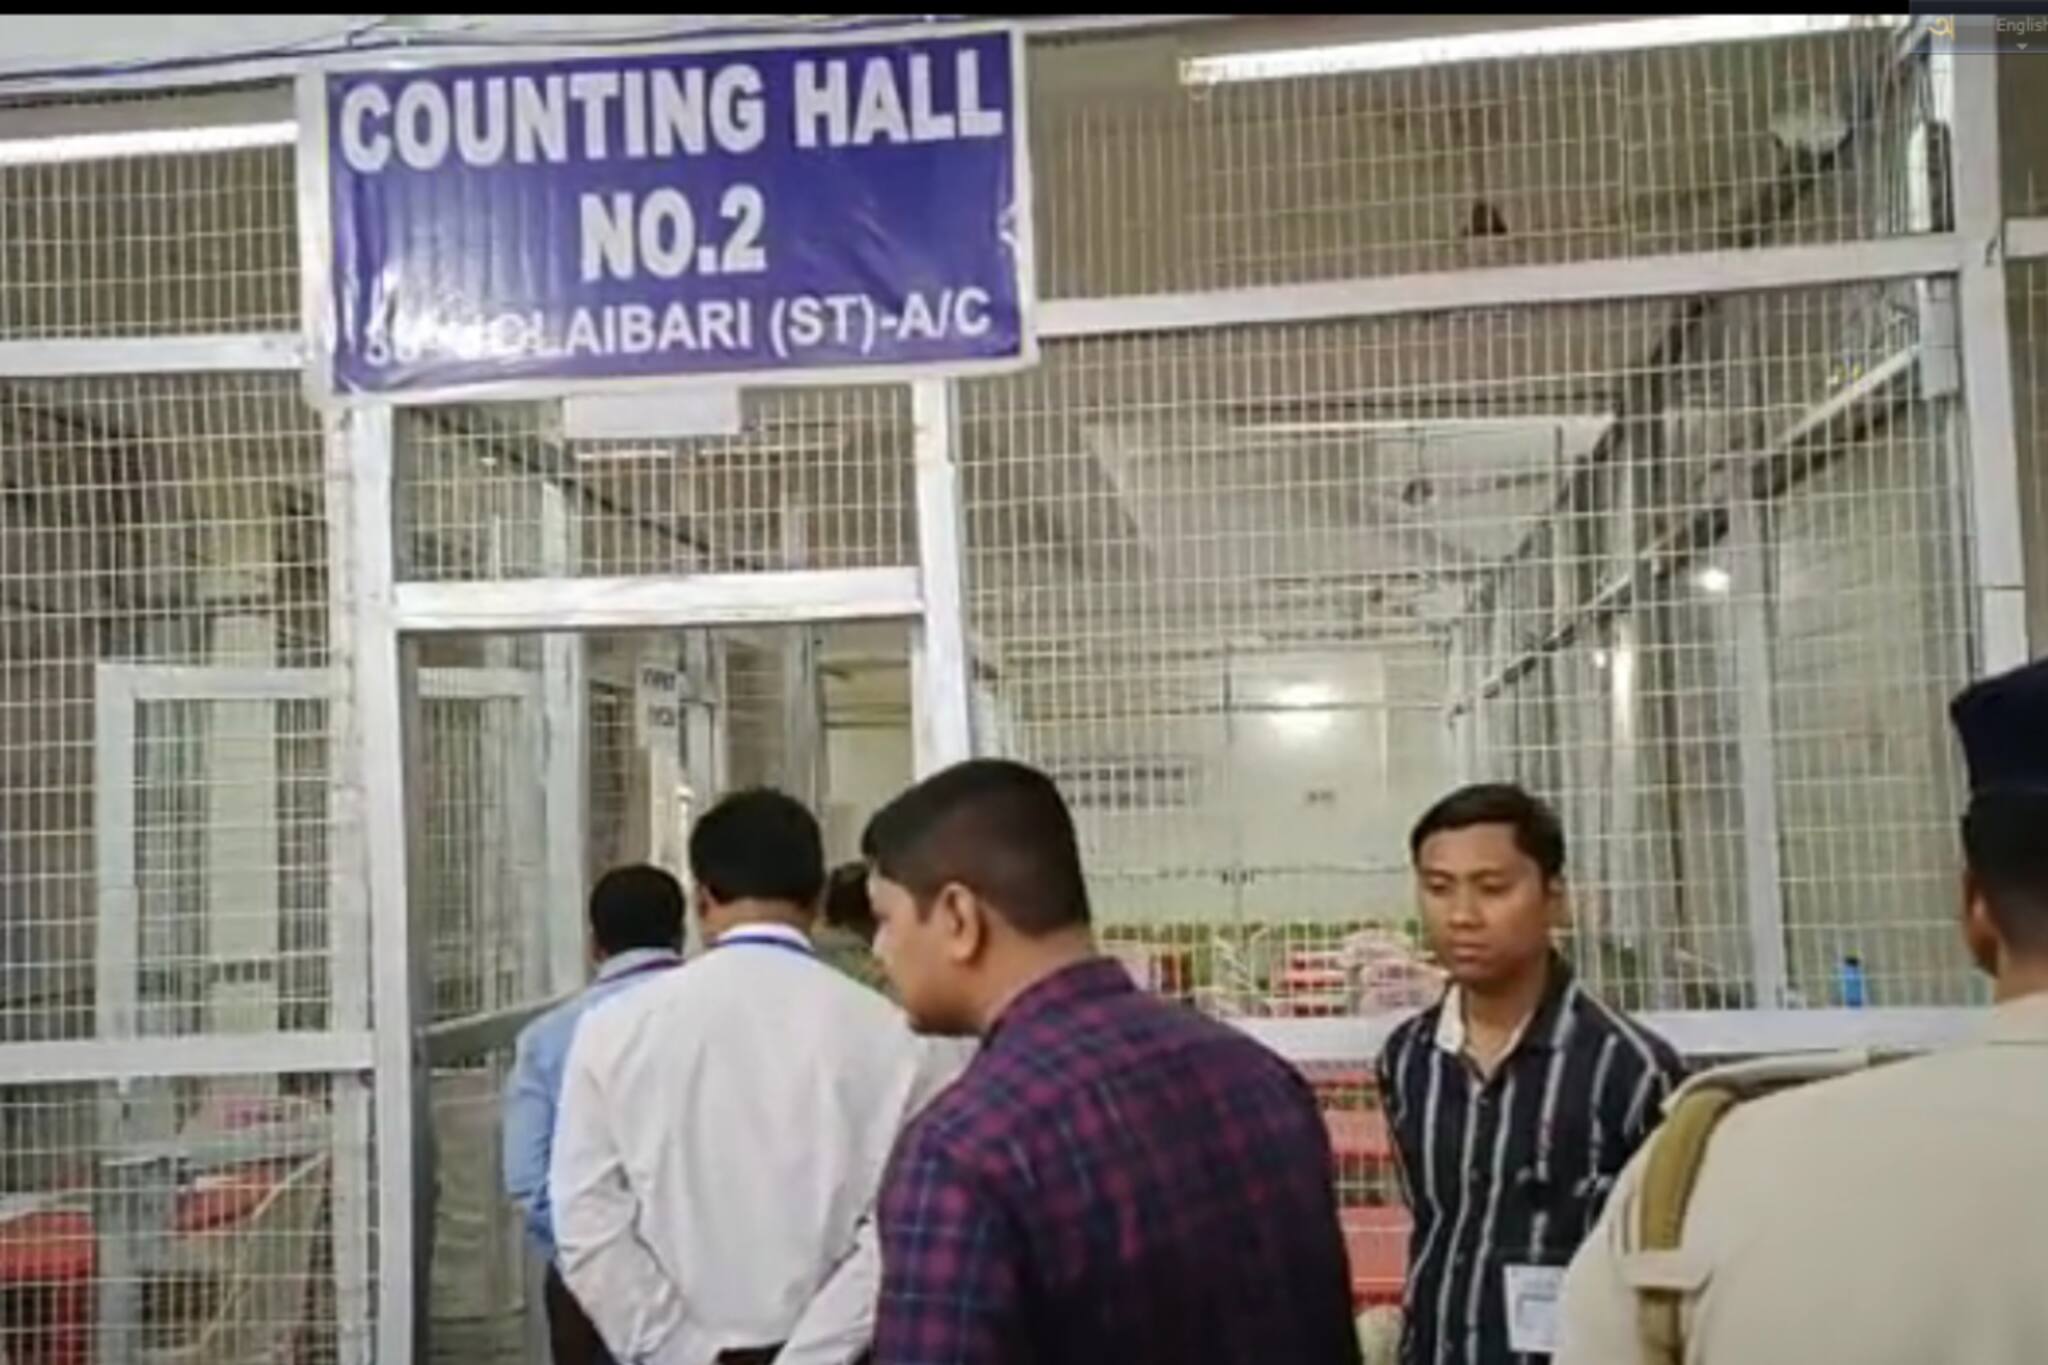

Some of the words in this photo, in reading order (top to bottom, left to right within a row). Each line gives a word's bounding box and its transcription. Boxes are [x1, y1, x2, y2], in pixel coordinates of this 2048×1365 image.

[340, 64, 766, 171] COUNTING
[794, 50, 1004, 148] HALL
[579, 184, 767, 282] NO.2
[769, 286, 992, 358] (ST)-A/C
